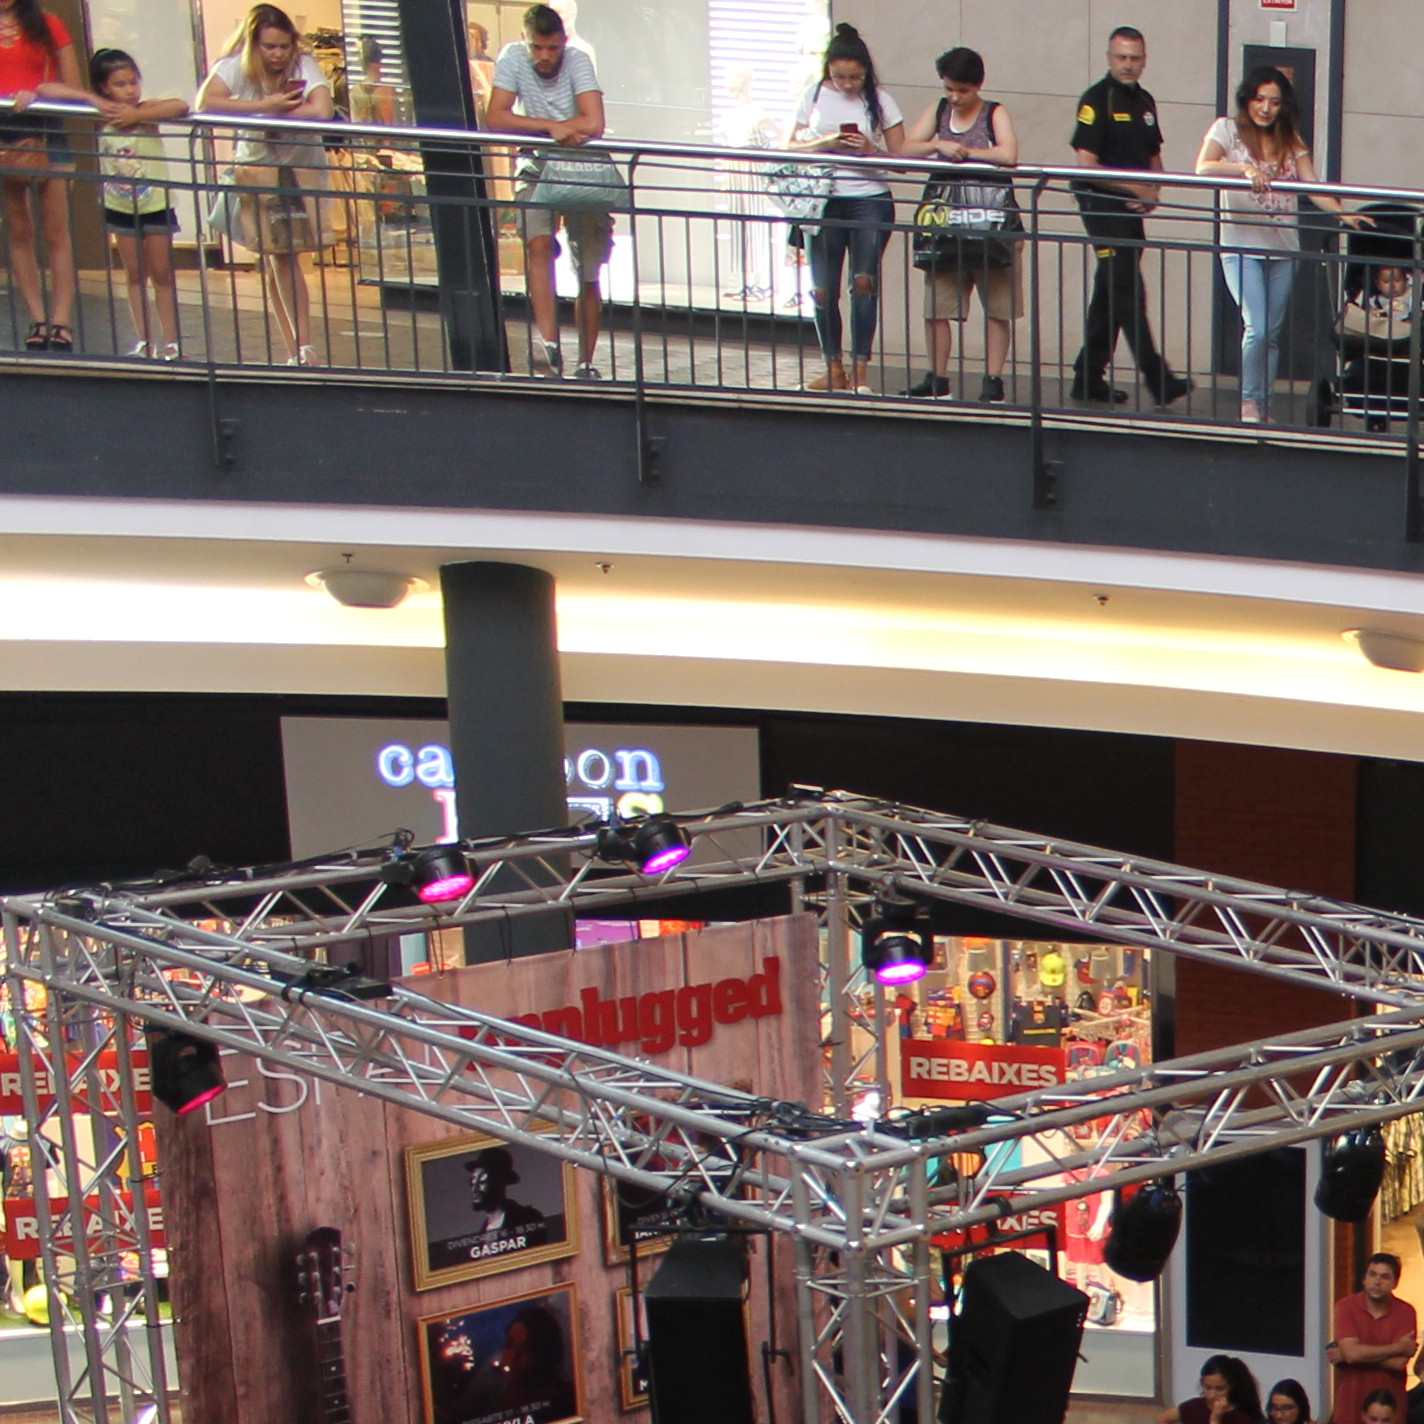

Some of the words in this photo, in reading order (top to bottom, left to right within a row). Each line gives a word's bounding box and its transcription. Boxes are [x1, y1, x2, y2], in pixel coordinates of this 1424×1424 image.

[378, 744, 665, 791] caon
[909, 1056, 1058, 1088] REBAIXES
[470, 1236, 527, 1259] GASPAR
